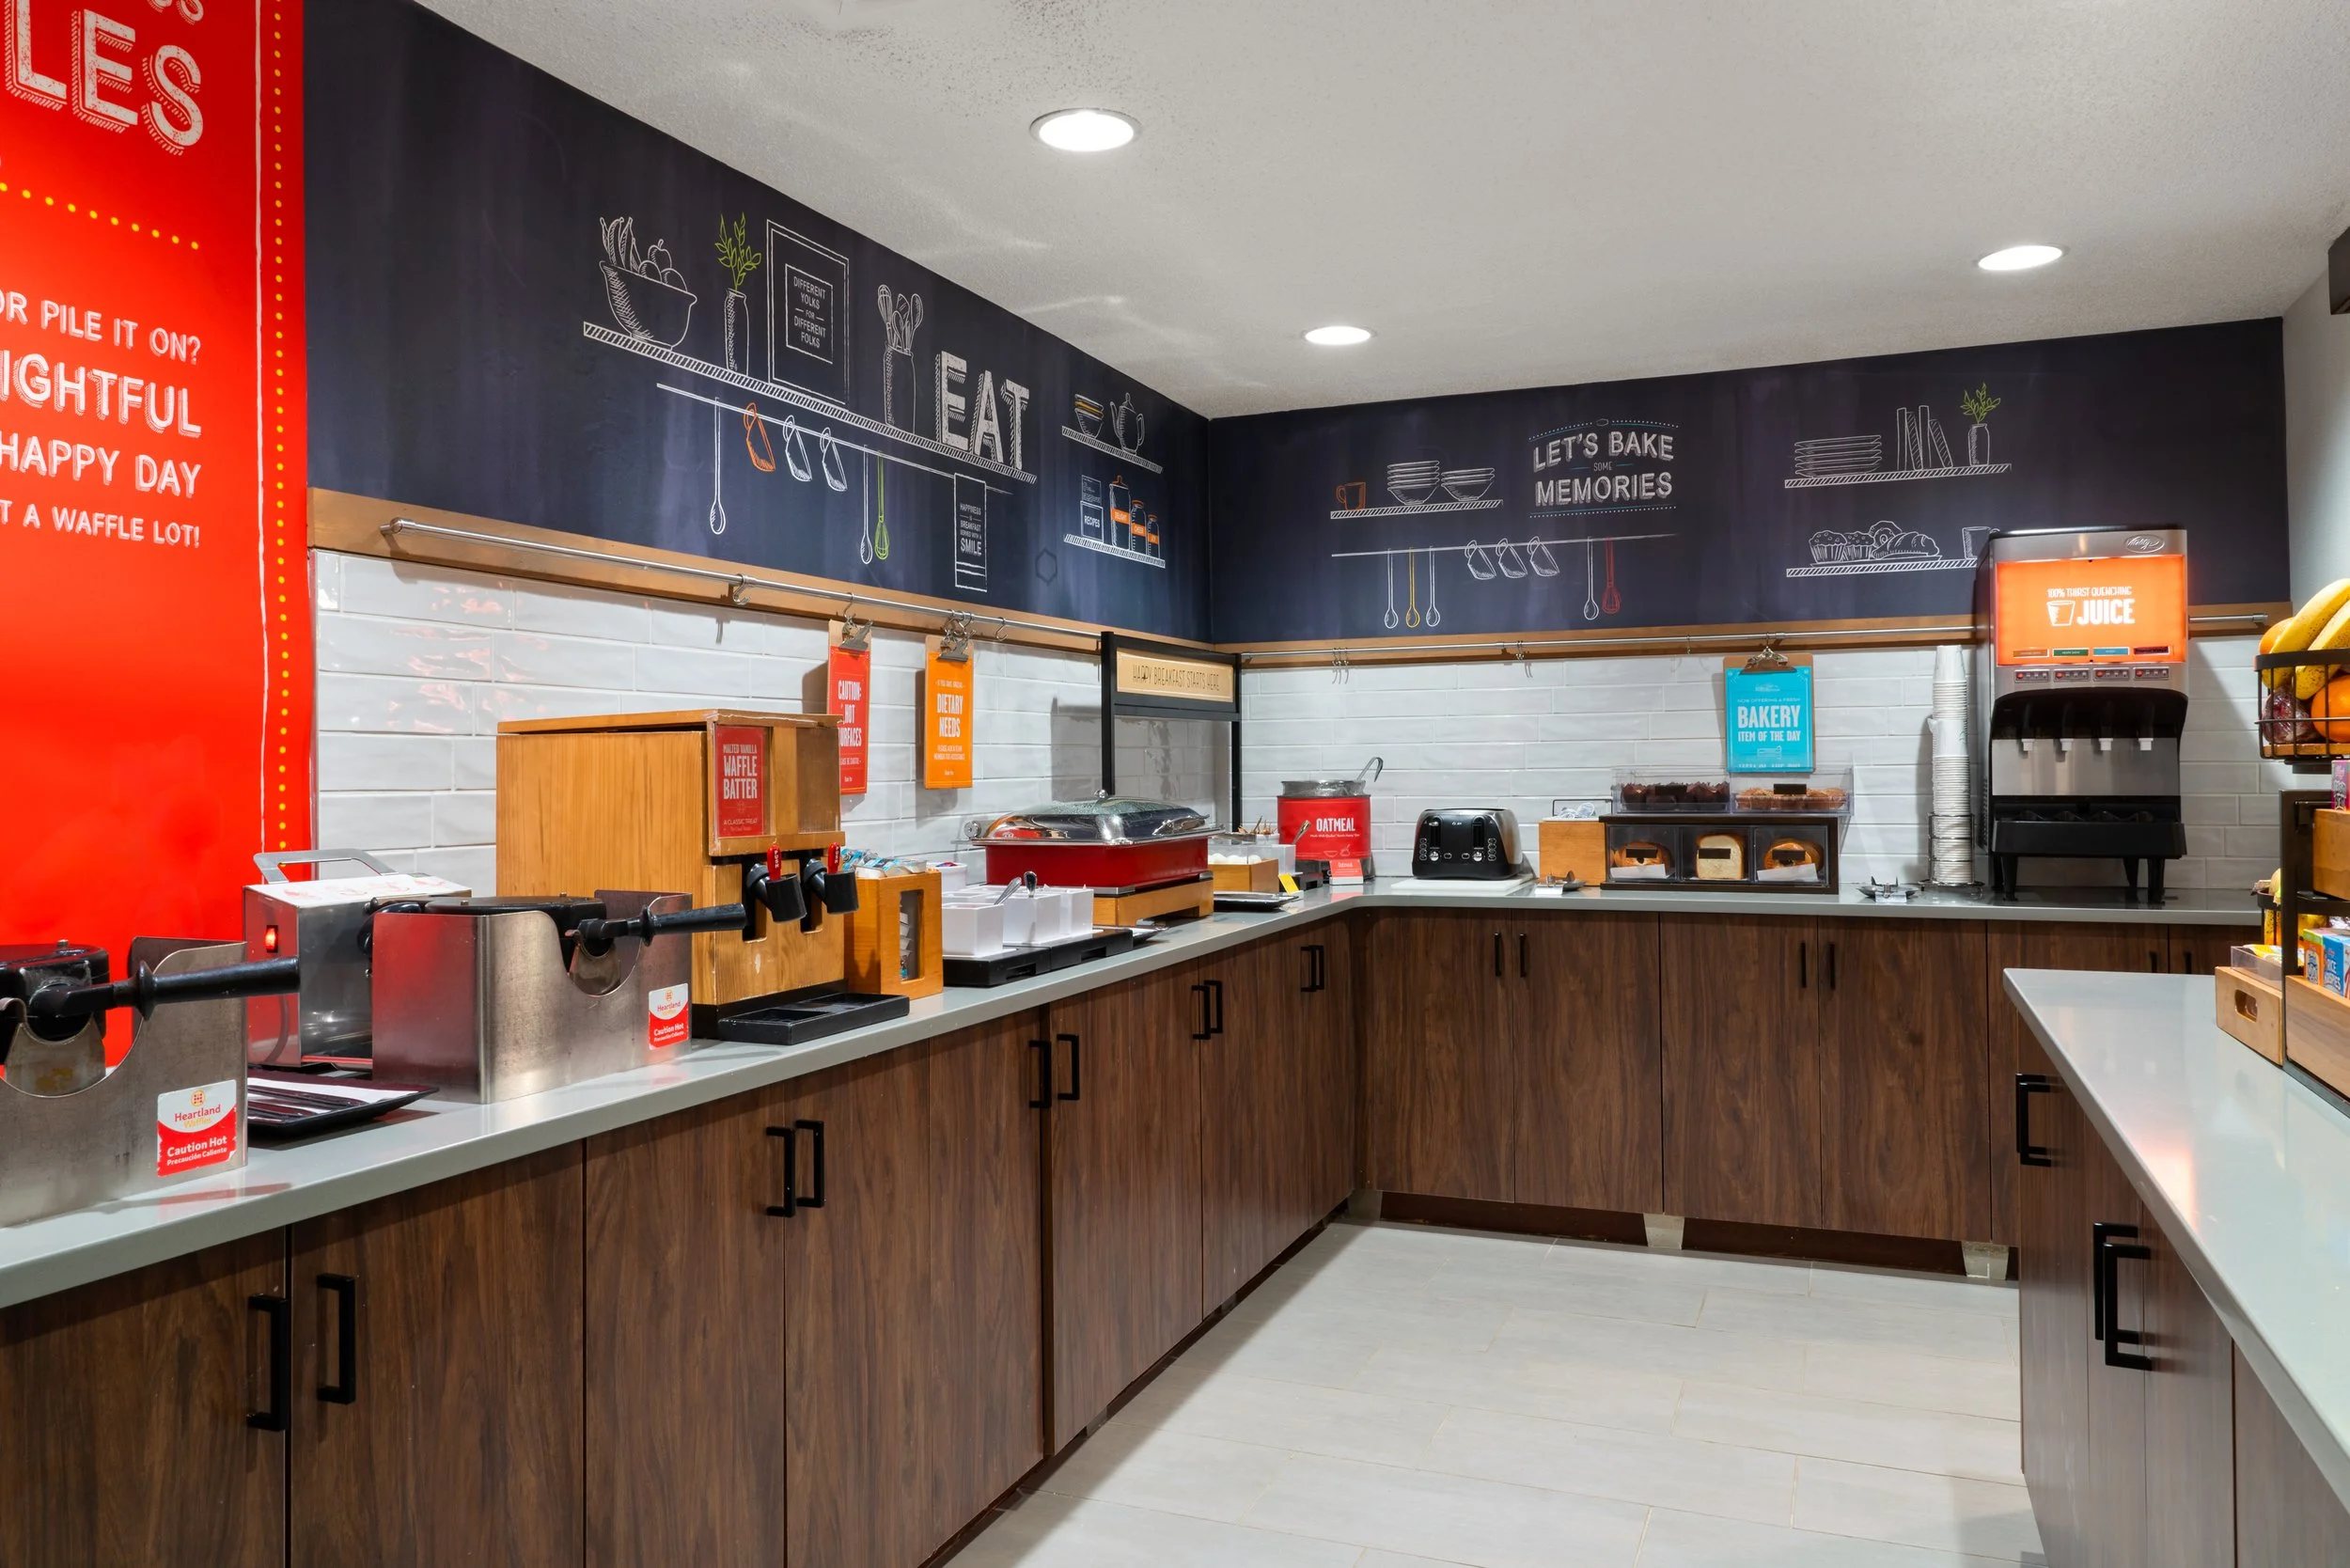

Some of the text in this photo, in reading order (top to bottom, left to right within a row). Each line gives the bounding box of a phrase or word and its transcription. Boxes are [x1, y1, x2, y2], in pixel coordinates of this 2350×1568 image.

[793, 276, 825, 300] DIFFERENT
[801, 292, 820, 309] YOLKS
[806, 309, 815, 320] FOR
[41, 300, 102, 341] PILE
[114, 318, 138, 350] IT
[149, 327, 201, 365] ON?
[793, 316, 826, 337] DIFFERENT
[801, 332, 820, 349] FOLKS
[0, 350, 201, 438] IGHTFUL
[935, 351, 1029, 470] EAT
[1533, 431, 1674, 472] LET'S BAKE
[0, 431, 201, 498] HAPPY DAY
[1593, 462, 1613, 471] SOME
[1535, 472, 1672, 506] MEMORIES
[23, 503, 40, 529] A
[52, 506, 144, 541] WAFFLE
[153, 520, 200, 548] LOT!
[1084, 515, 1101, 528] RECIPES
[960, 537, 982, 556] SMILE
[2047, 586, 2133, 598] 100% THIRST QUENCHING
[2076, 599, 2136, 625] JUICE
[1153, 666, 1185, 688] BREAKFAST
[838, 680, 862, 701] CAUTION:
[844, 704, 855, 724] HOT
[937, 693, 964, 714] DIETARY
[939, 716, 961, 738] NEEDS
[1737, 705, 1801, 729] BAKERY
[1738, 730, 1801, 742] ITEM OF THE DAY
[723, 744, 758, 753] MALTED VANILLA
[723, 755, 758, 776] WAFFLE
[723, 778, 758, 799] BATTER
[1316, 817, 1355, 832] OATMEAL
[654, 1026, 674, 1036] Caution
[175, 1104, 221, 1122] Heartland
[166, 1147, 227, 1166] Precaución Caliente
[167, 1135, 227, 1157] Caution Hot
